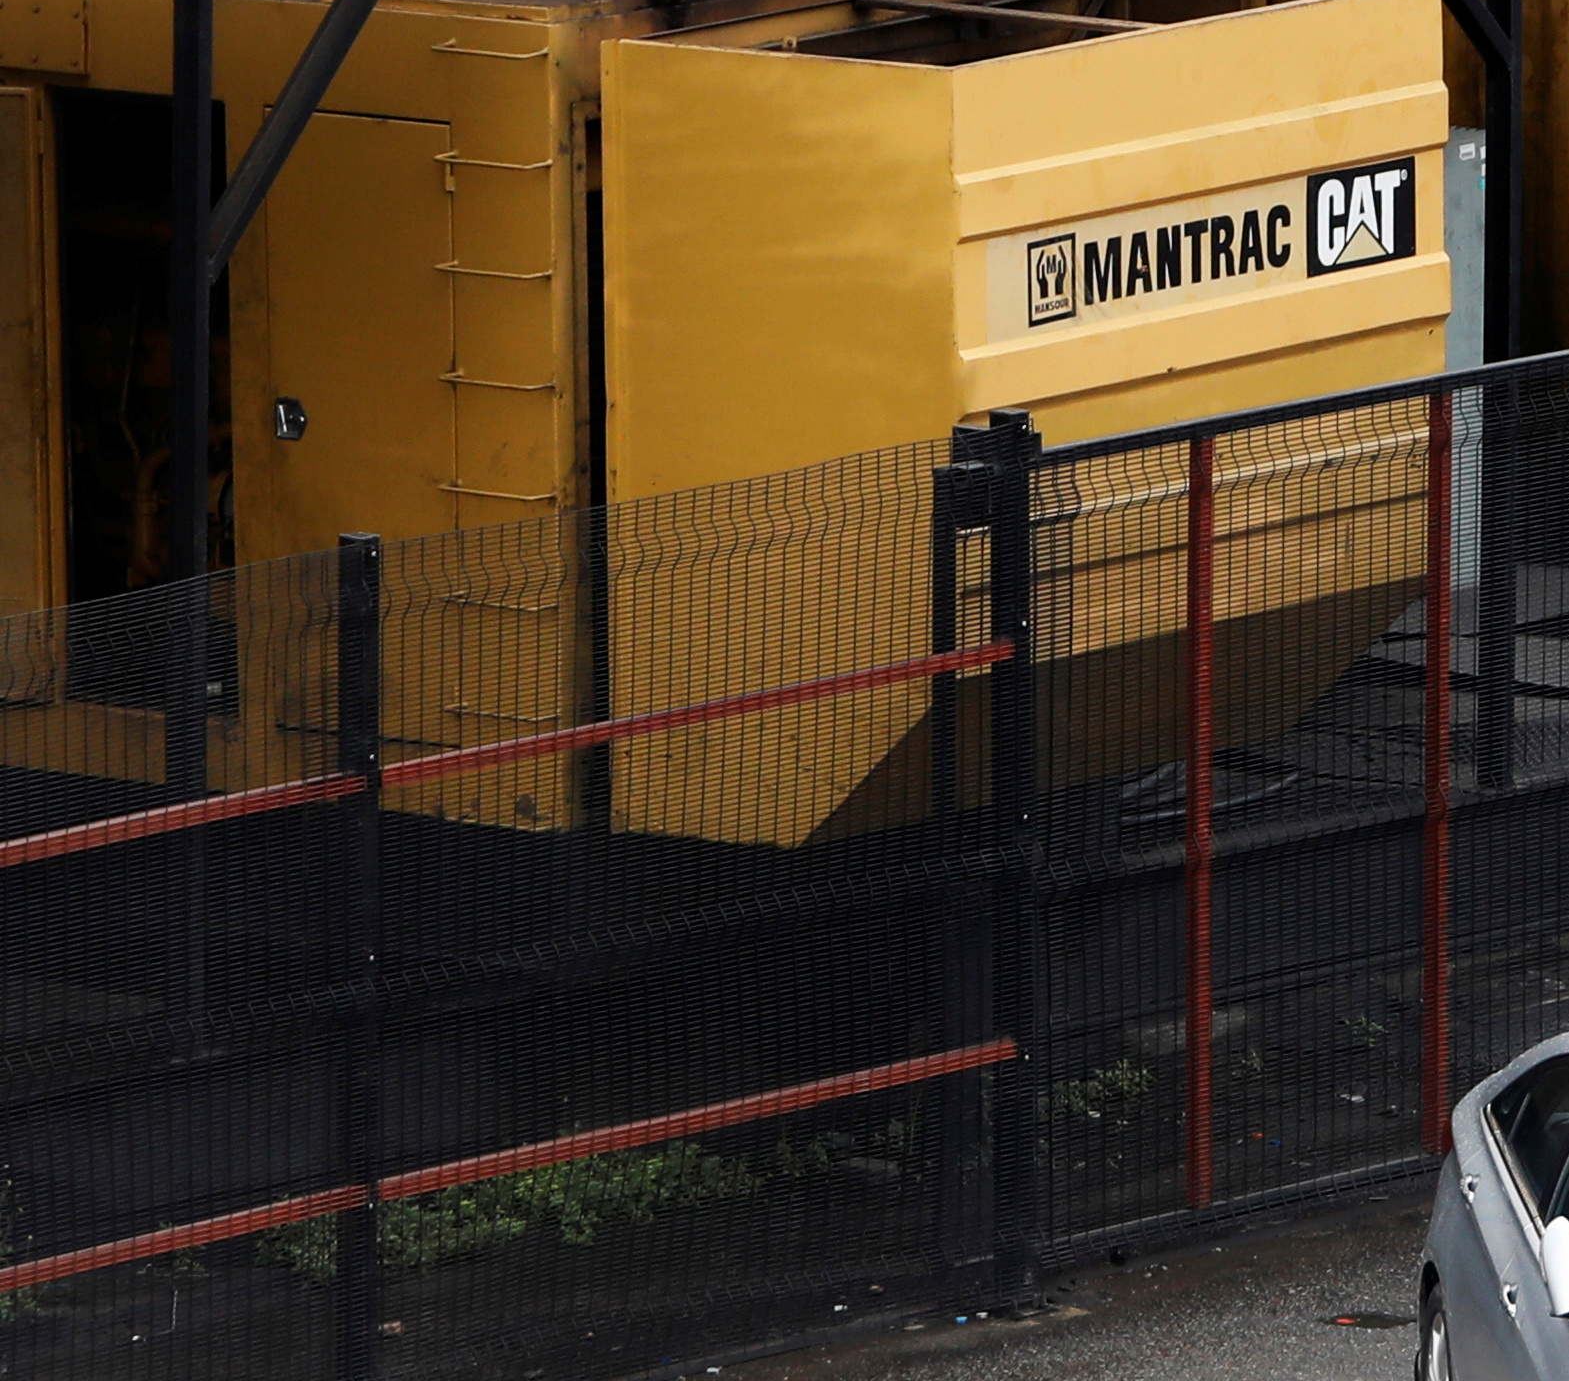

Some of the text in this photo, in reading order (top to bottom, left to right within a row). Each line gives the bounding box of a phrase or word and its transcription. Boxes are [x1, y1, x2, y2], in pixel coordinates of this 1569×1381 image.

[1083, 169, 1401, 305] MANTRAC CAT
[1034, 297, 1070, 315] MANSOUR
